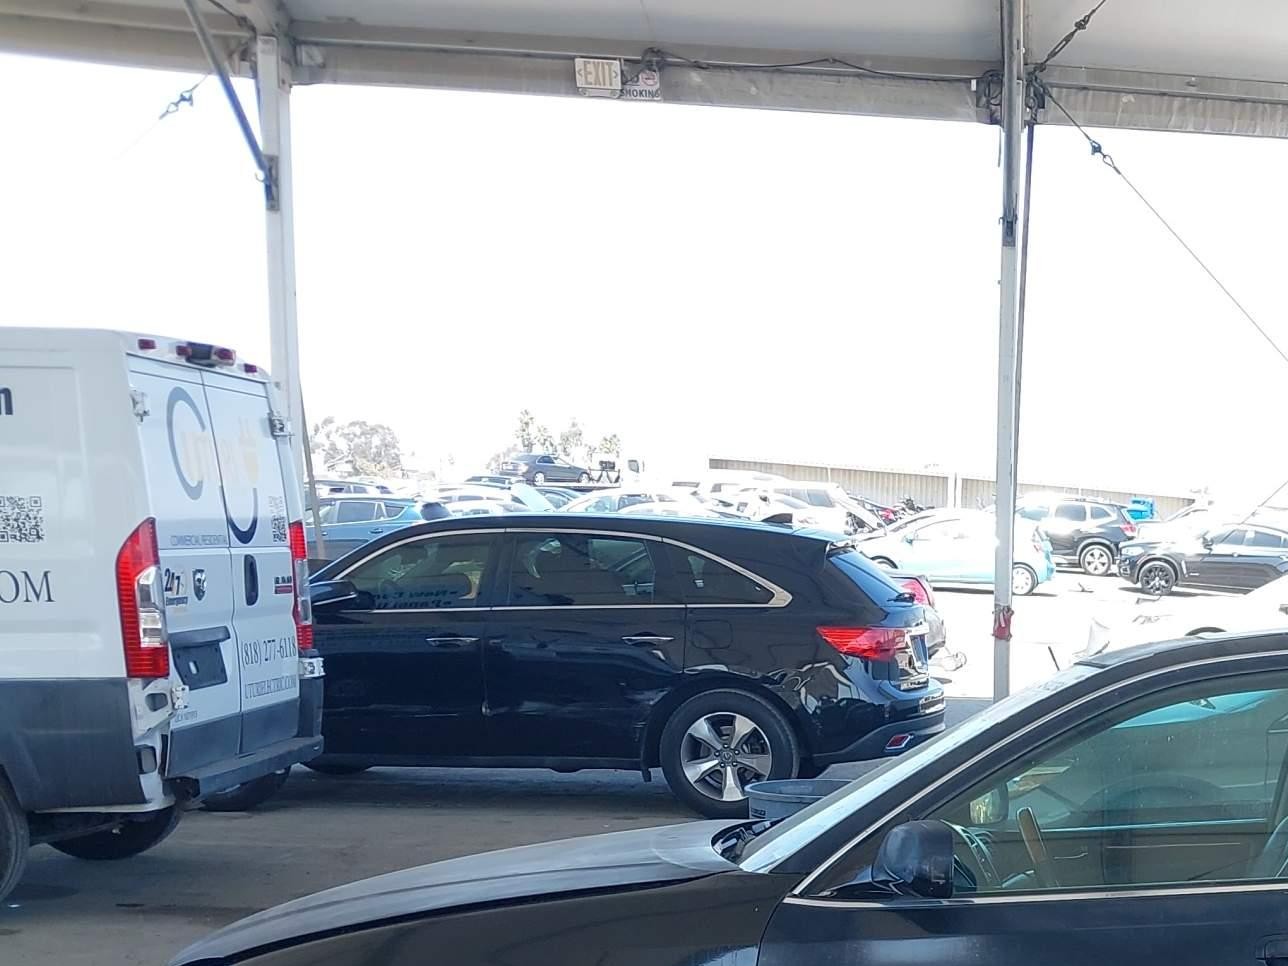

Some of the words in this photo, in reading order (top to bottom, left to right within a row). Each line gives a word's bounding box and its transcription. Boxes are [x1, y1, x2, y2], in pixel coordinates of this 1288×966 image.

[583, 60, 613, 87] EXIT
[241, 640, 262, 670] (818)
[263, 636, 297, 662] 277-6118
